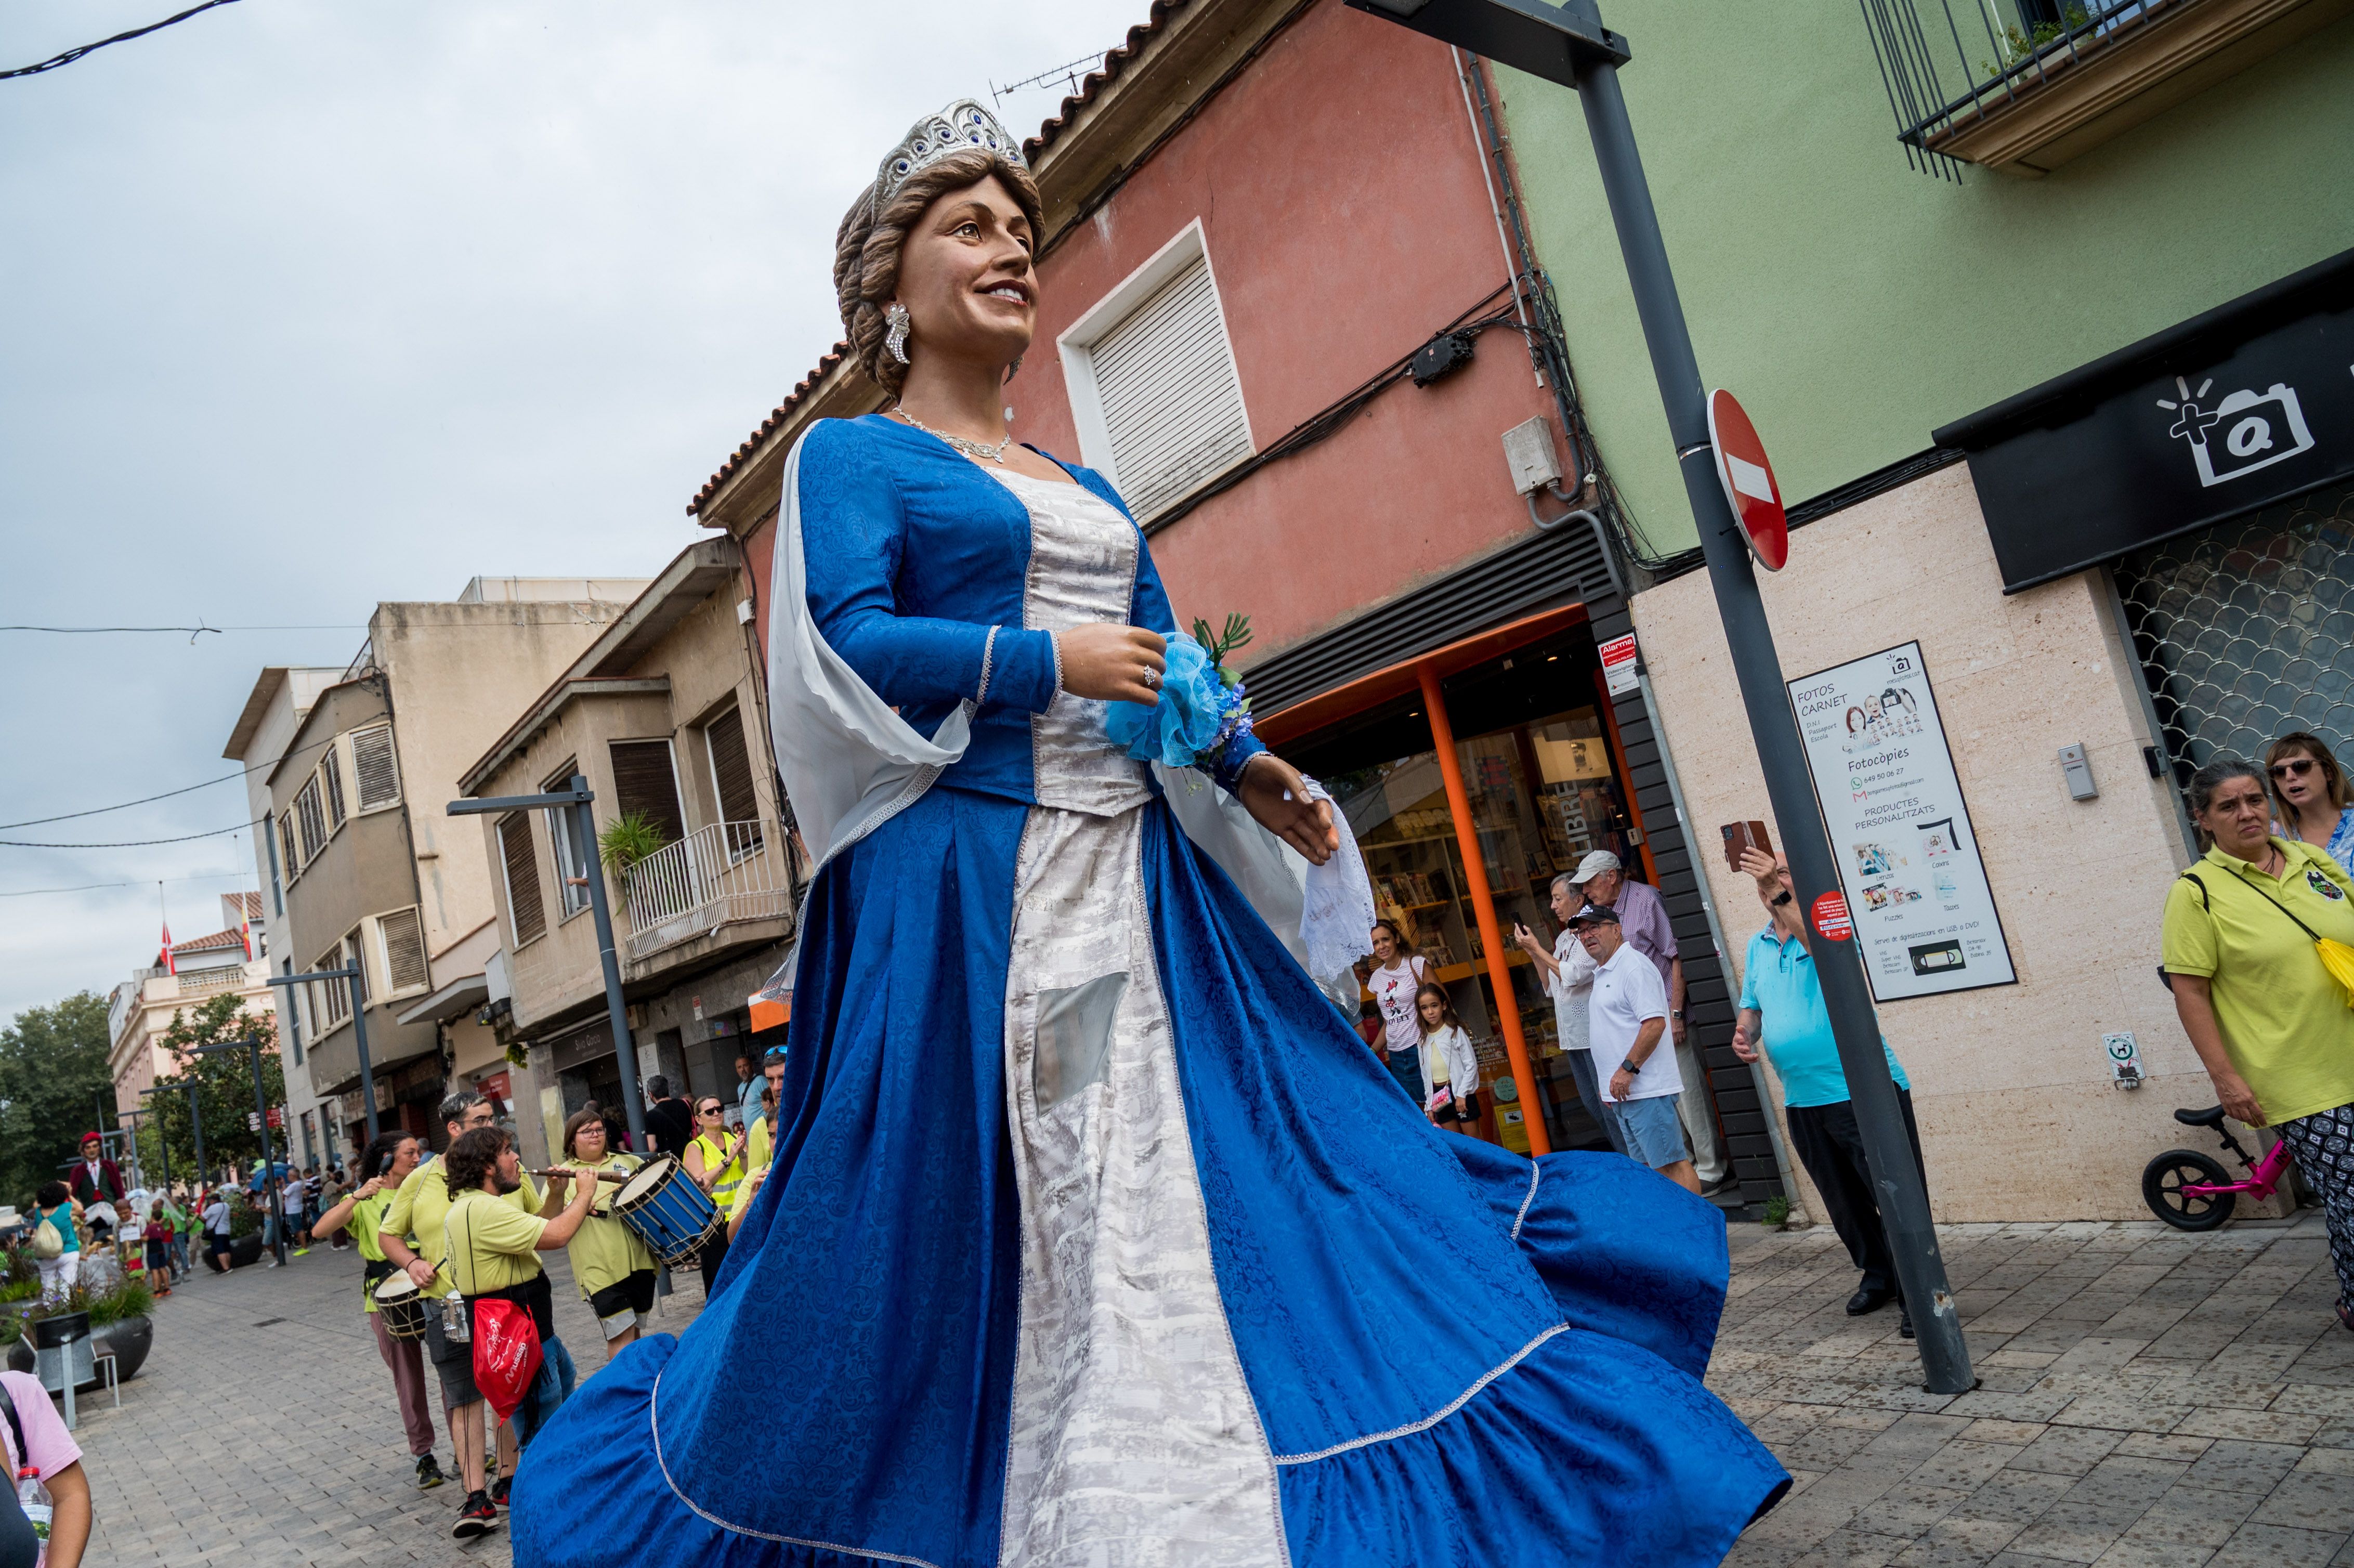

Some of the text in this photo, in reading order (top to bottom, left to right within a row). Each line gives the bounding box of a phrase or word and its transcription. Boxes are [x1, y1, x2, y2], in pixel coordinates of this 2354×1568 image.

[1603, 639, 1632, 654] Alarma
[1798, 684, 1835, 703] FOTOS
[1801, 694, 1848, 716] CARNET
[1809, 723, 1837, 735] Passaport
[1811, 734, 1828, 743] Escola
[1848, 748, 1910, 772] Fotocòpies
[1855, 804, 1935, 830] PERSONALITZATS
[1865, 798, 1919, 817] PRODUCTES
[1899, 930, 1936, 942] digitalitzacions
[1965, 921, 1980, 930] DVD!
